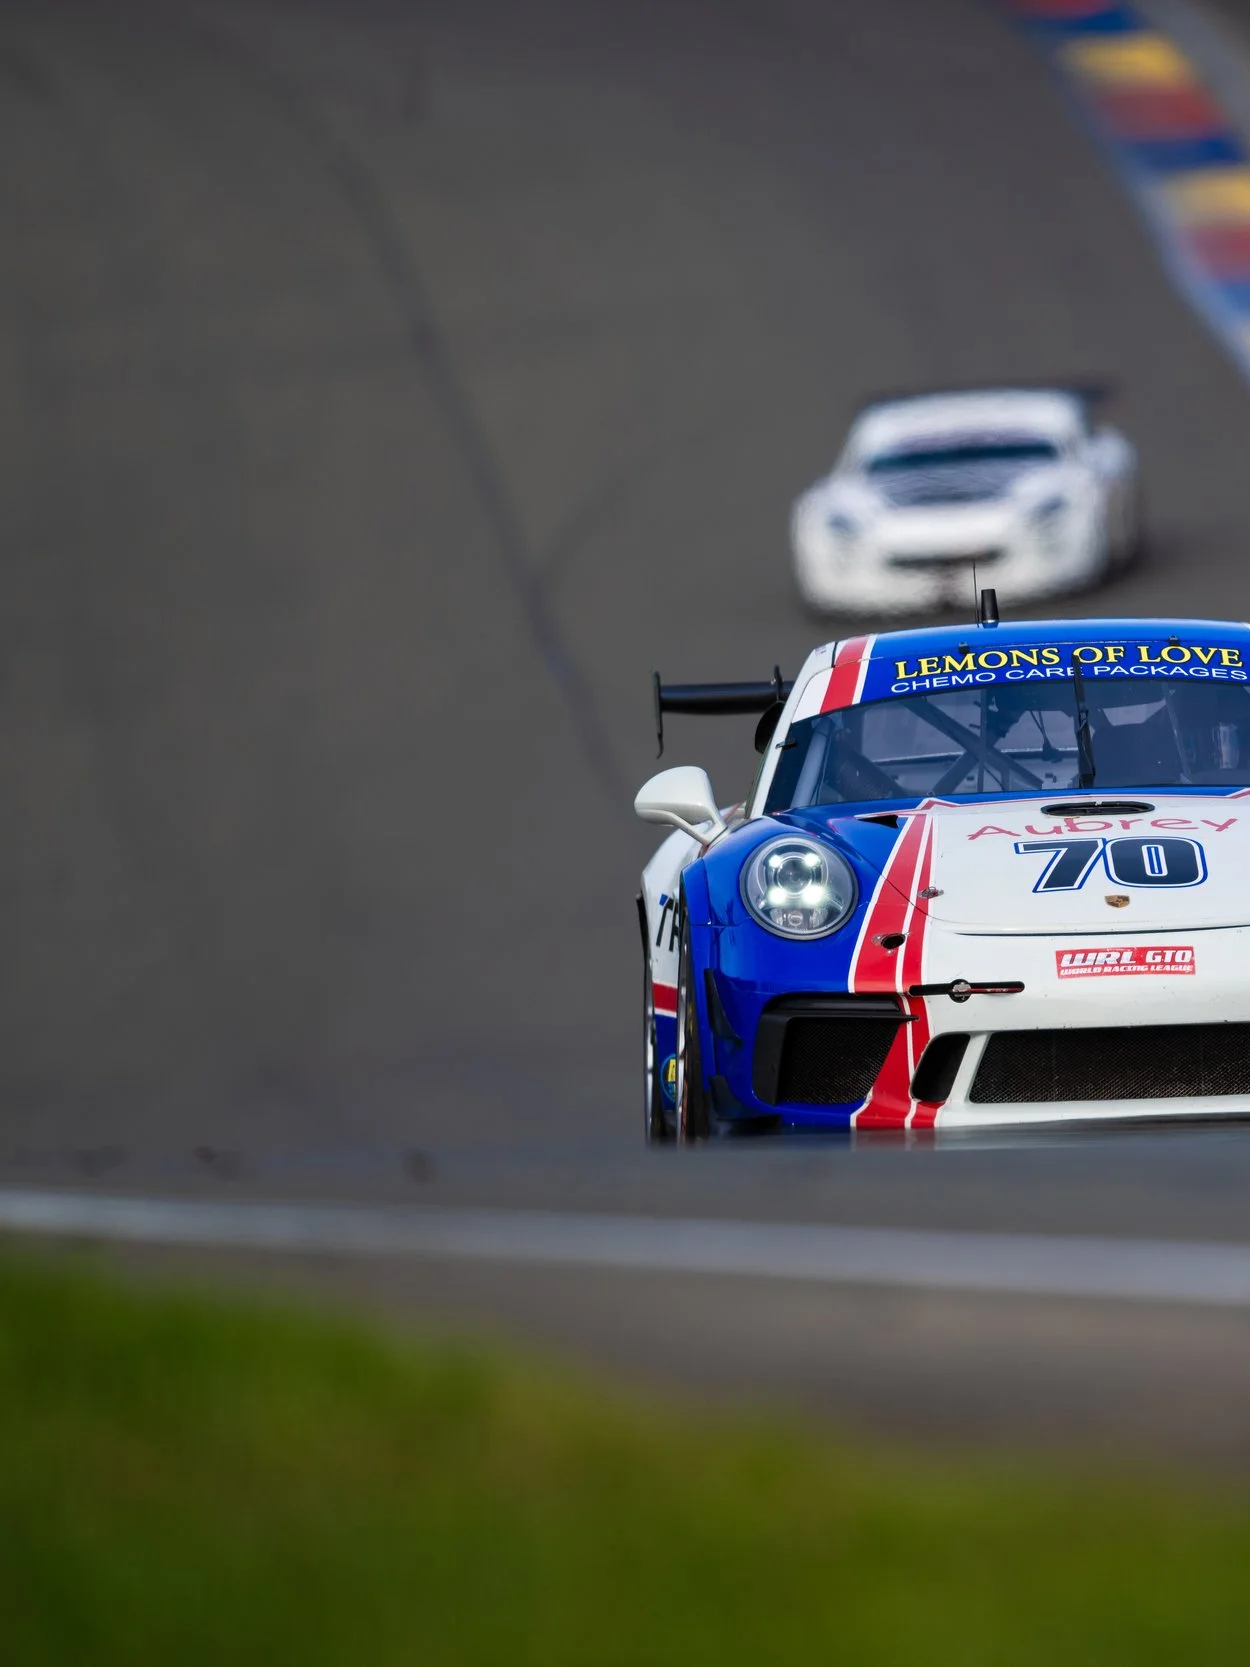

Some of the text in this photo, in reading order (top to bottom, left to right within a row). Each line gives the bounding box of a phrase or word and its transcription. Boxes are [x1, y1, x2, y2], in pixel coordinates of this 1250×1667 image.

[895, 645, 1243, 680] LEMONS OF LOVE
[891, 665, 1248, 693] CHEMO CARE PACKAGES
[967, 817, 1239, 840] Aubrey
[1013, 836, 1209, 893] 70
[1060, 950, 1193, 967] WRL GTO
[1060, 964, 1193, 976] WORLD RACING LEAGUE
